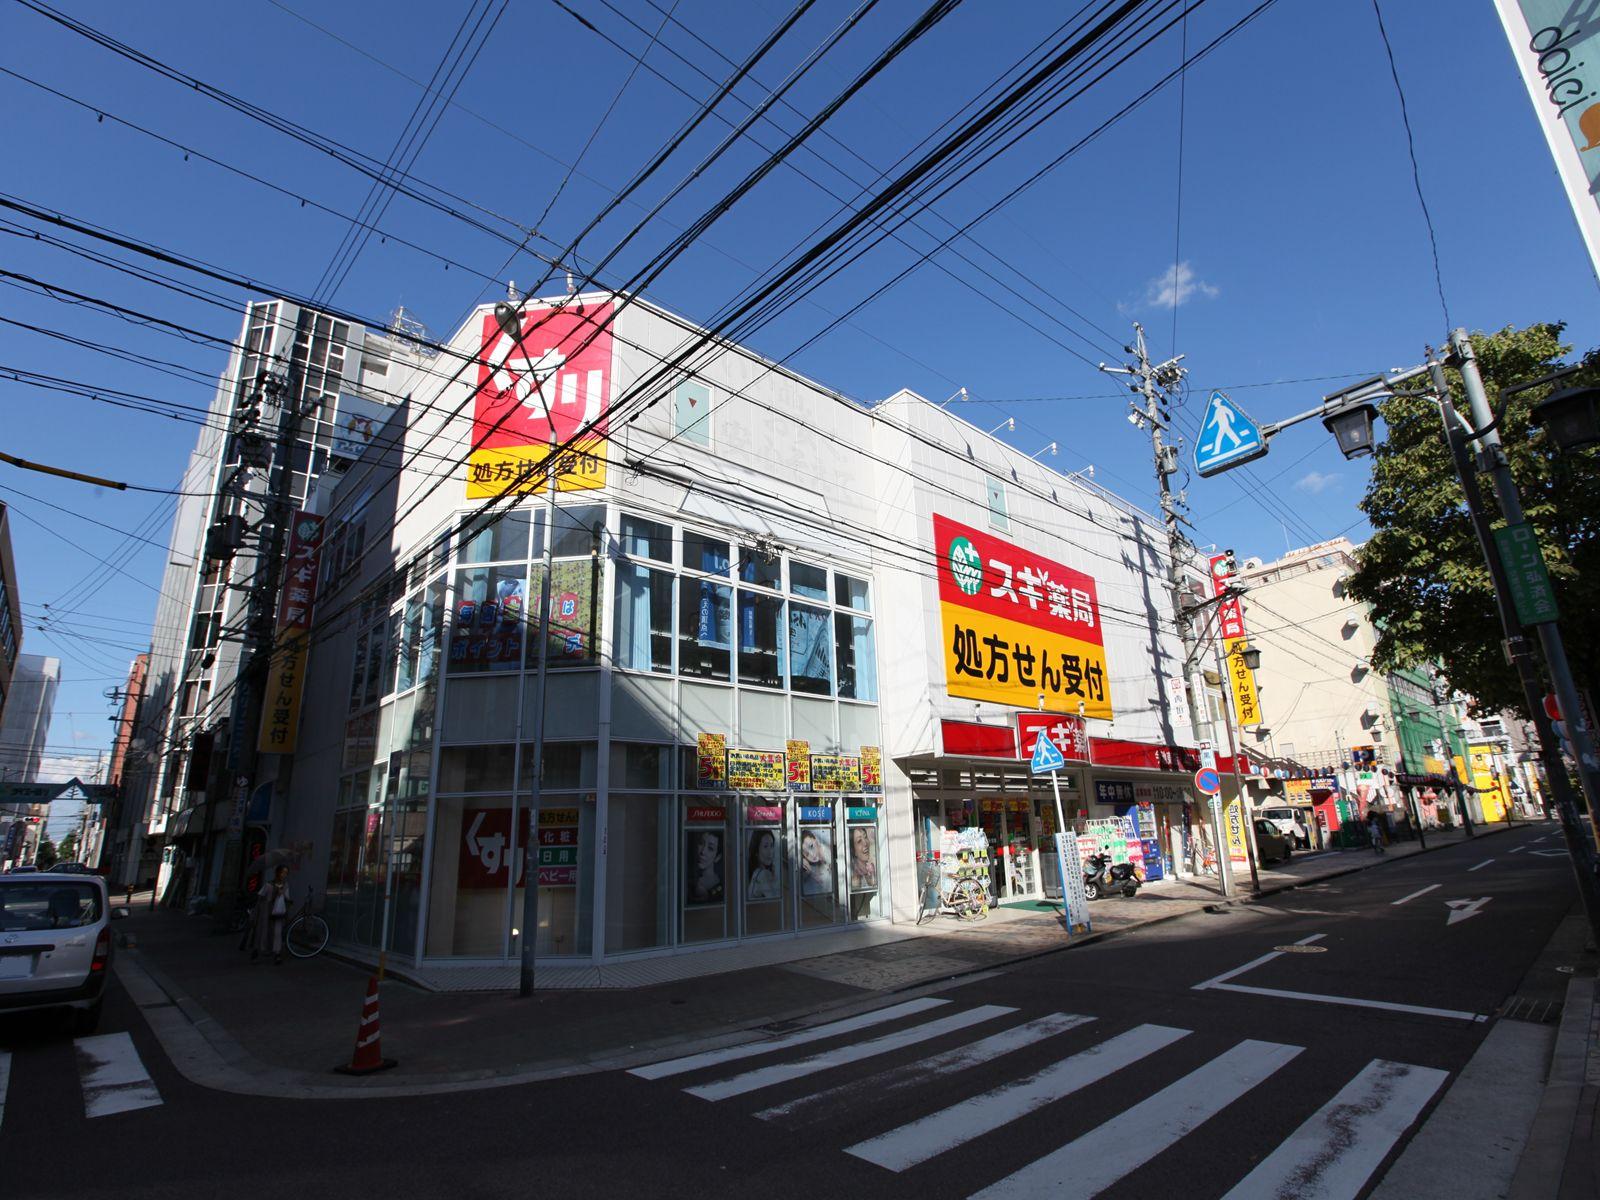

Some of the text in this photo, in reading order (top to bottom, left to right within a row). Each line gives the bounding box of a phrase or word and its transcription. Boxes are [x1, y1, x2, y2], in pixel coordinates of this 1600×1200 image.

[487, 317, 603, 434] くすり
[286, 544, 317, 624] スギ薬局
[988, 559, 1095, 628] スギ薬局
[269, 636, 297, 745] 処方せん受付
[952, 623, 1105, 702] 処方せん受付
[1230, 641, 1254, 720] 処方せん受付
[700, 755, 713, 779] 5
[787, 760, 799, 782] 5
[861, 766, 873, 784] 5
[465, 811, 524, 889] くすり
